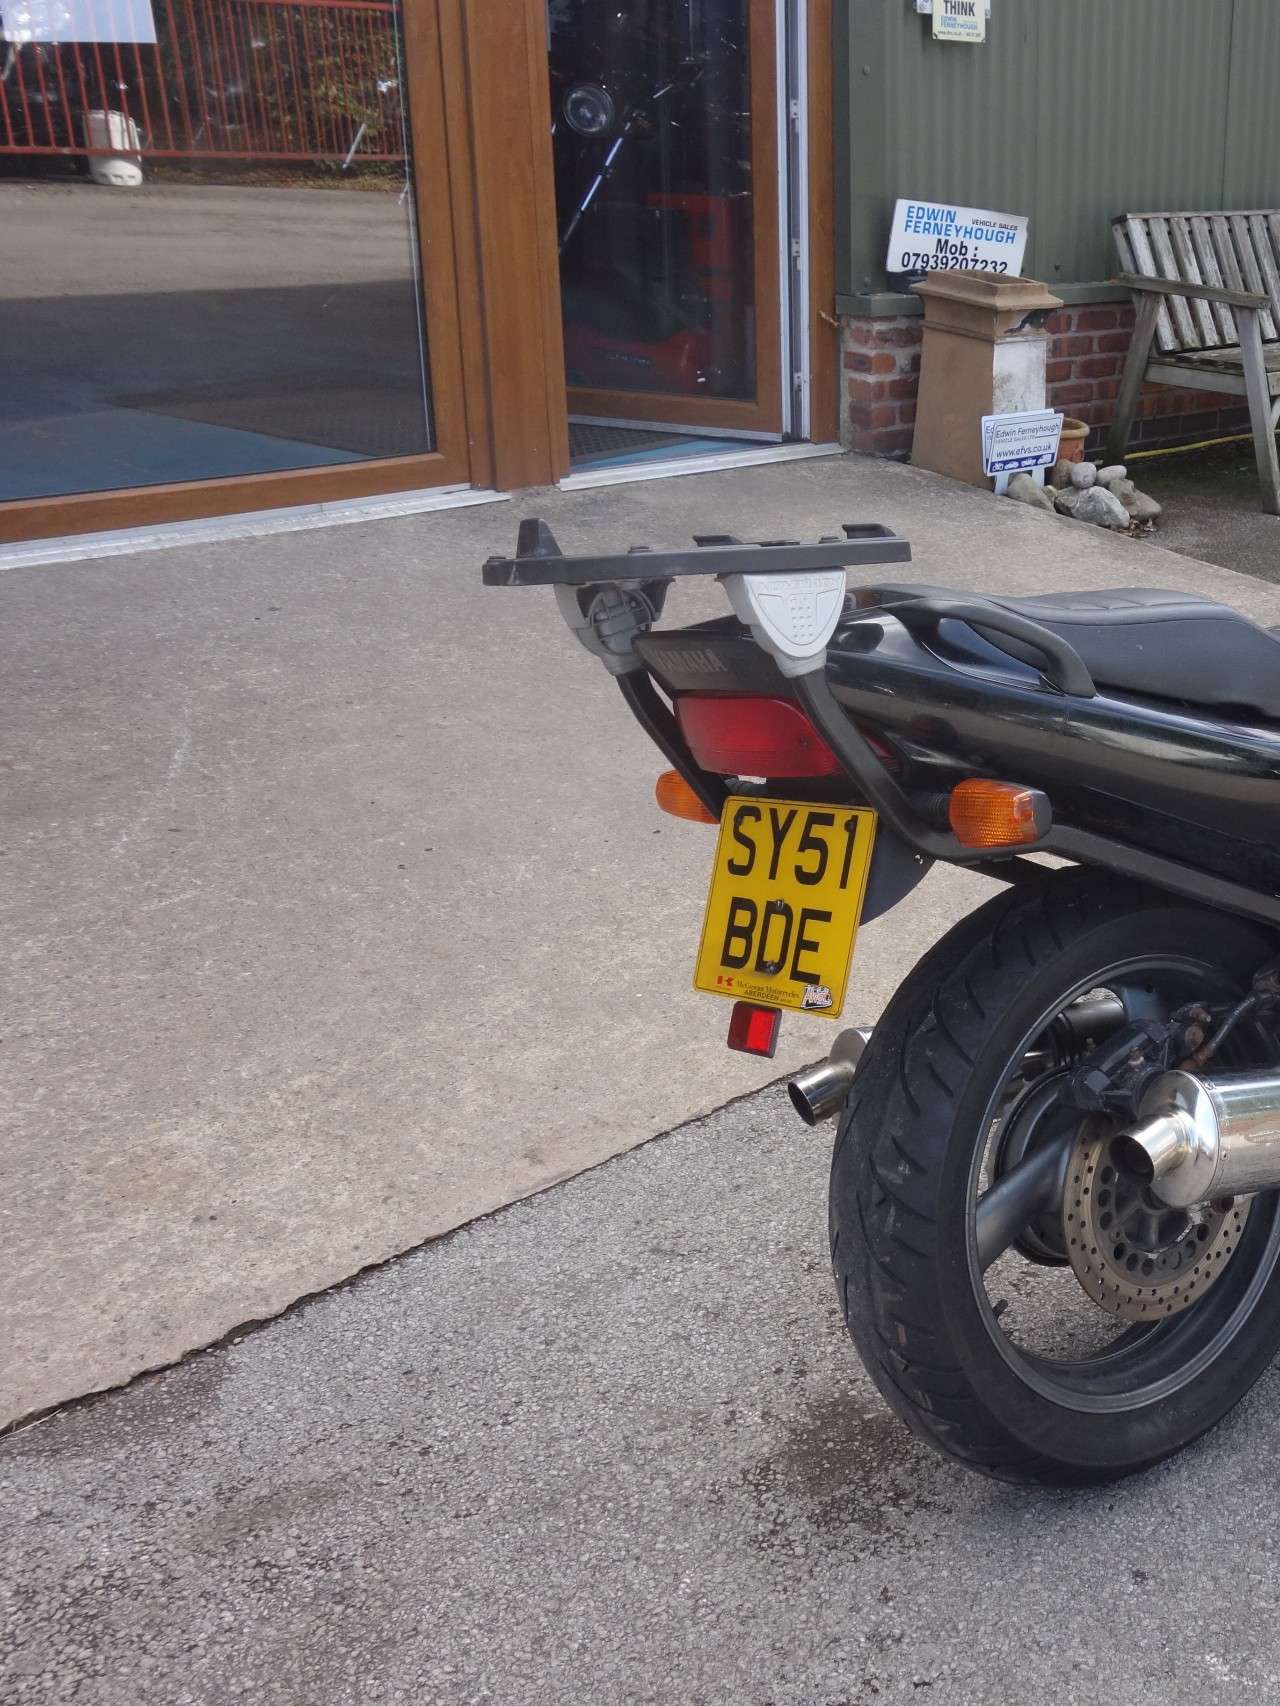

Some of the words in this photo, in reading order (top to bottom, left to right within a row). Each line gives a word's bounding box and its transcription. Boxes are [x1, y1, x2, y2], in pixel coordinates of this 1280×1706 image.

[944, 0, 975, 17] THINK
[906, 205, 957, 223] EDWIN
[904, 219, 1016, 244] FERNEYHOUGH
[971, 218, 997, 229] VEHICLE
[998, 223, 1018, 232] SALES
[935, 238, 968, 257] Mob
[901, 252, 1008, 274] 07939207232
[995, 428, 1017, 439] Edwin
[996, 443, 1052, 458] www.efvs.co.uk
[727, 804, 859, 890] SY51
[720, 896, 832, 985] BDE
